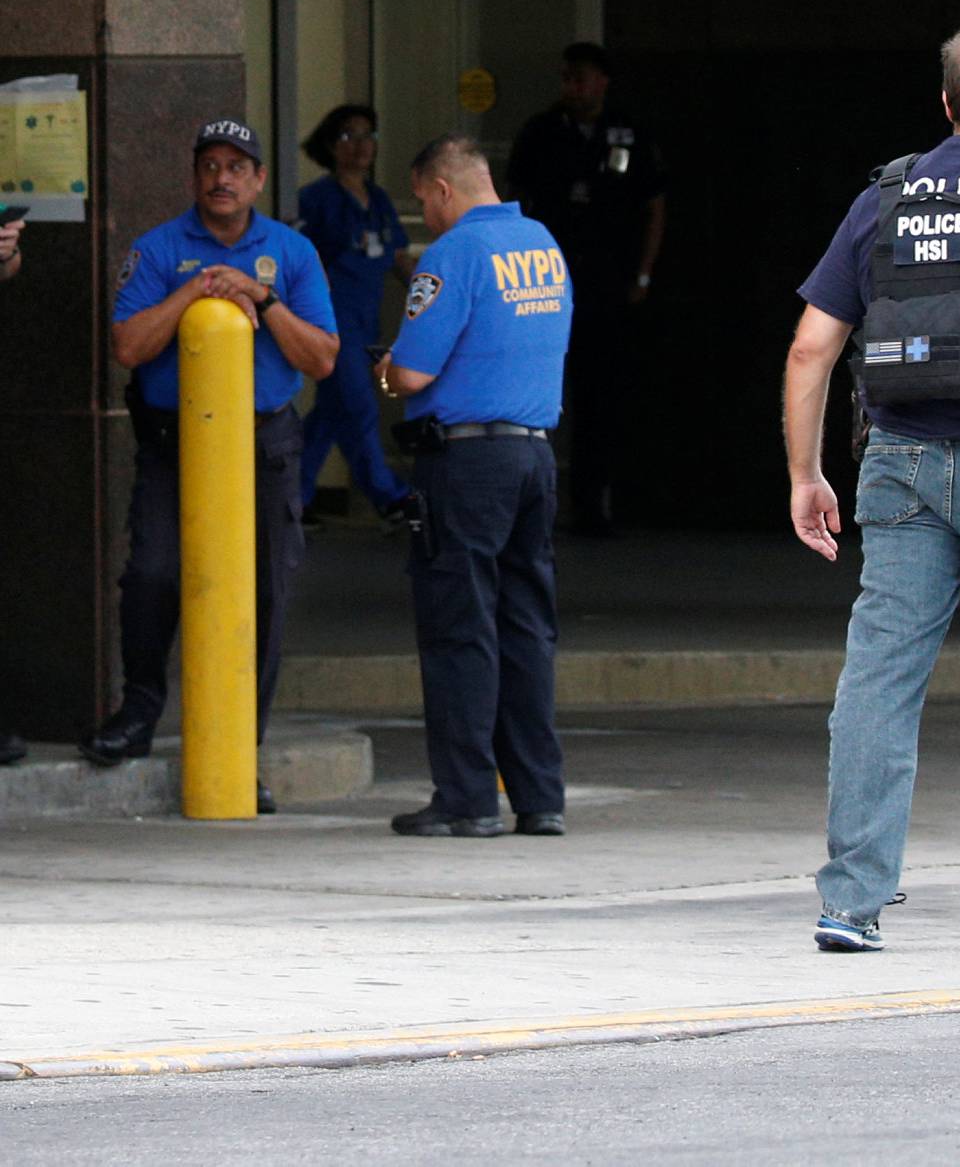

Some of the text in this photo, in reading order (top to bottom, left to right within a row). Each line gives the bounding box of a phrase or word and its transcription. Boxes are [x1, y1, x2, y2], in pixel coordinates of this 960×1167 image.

[204, 120, 251, 141] NYPD
[914, 239, 947, 261] HSI
[492, 248, 566, 290] NYPD
[503, 285, 565, 303] COMMUNITY
[516, 300, 561, 316] AFFAIRS
